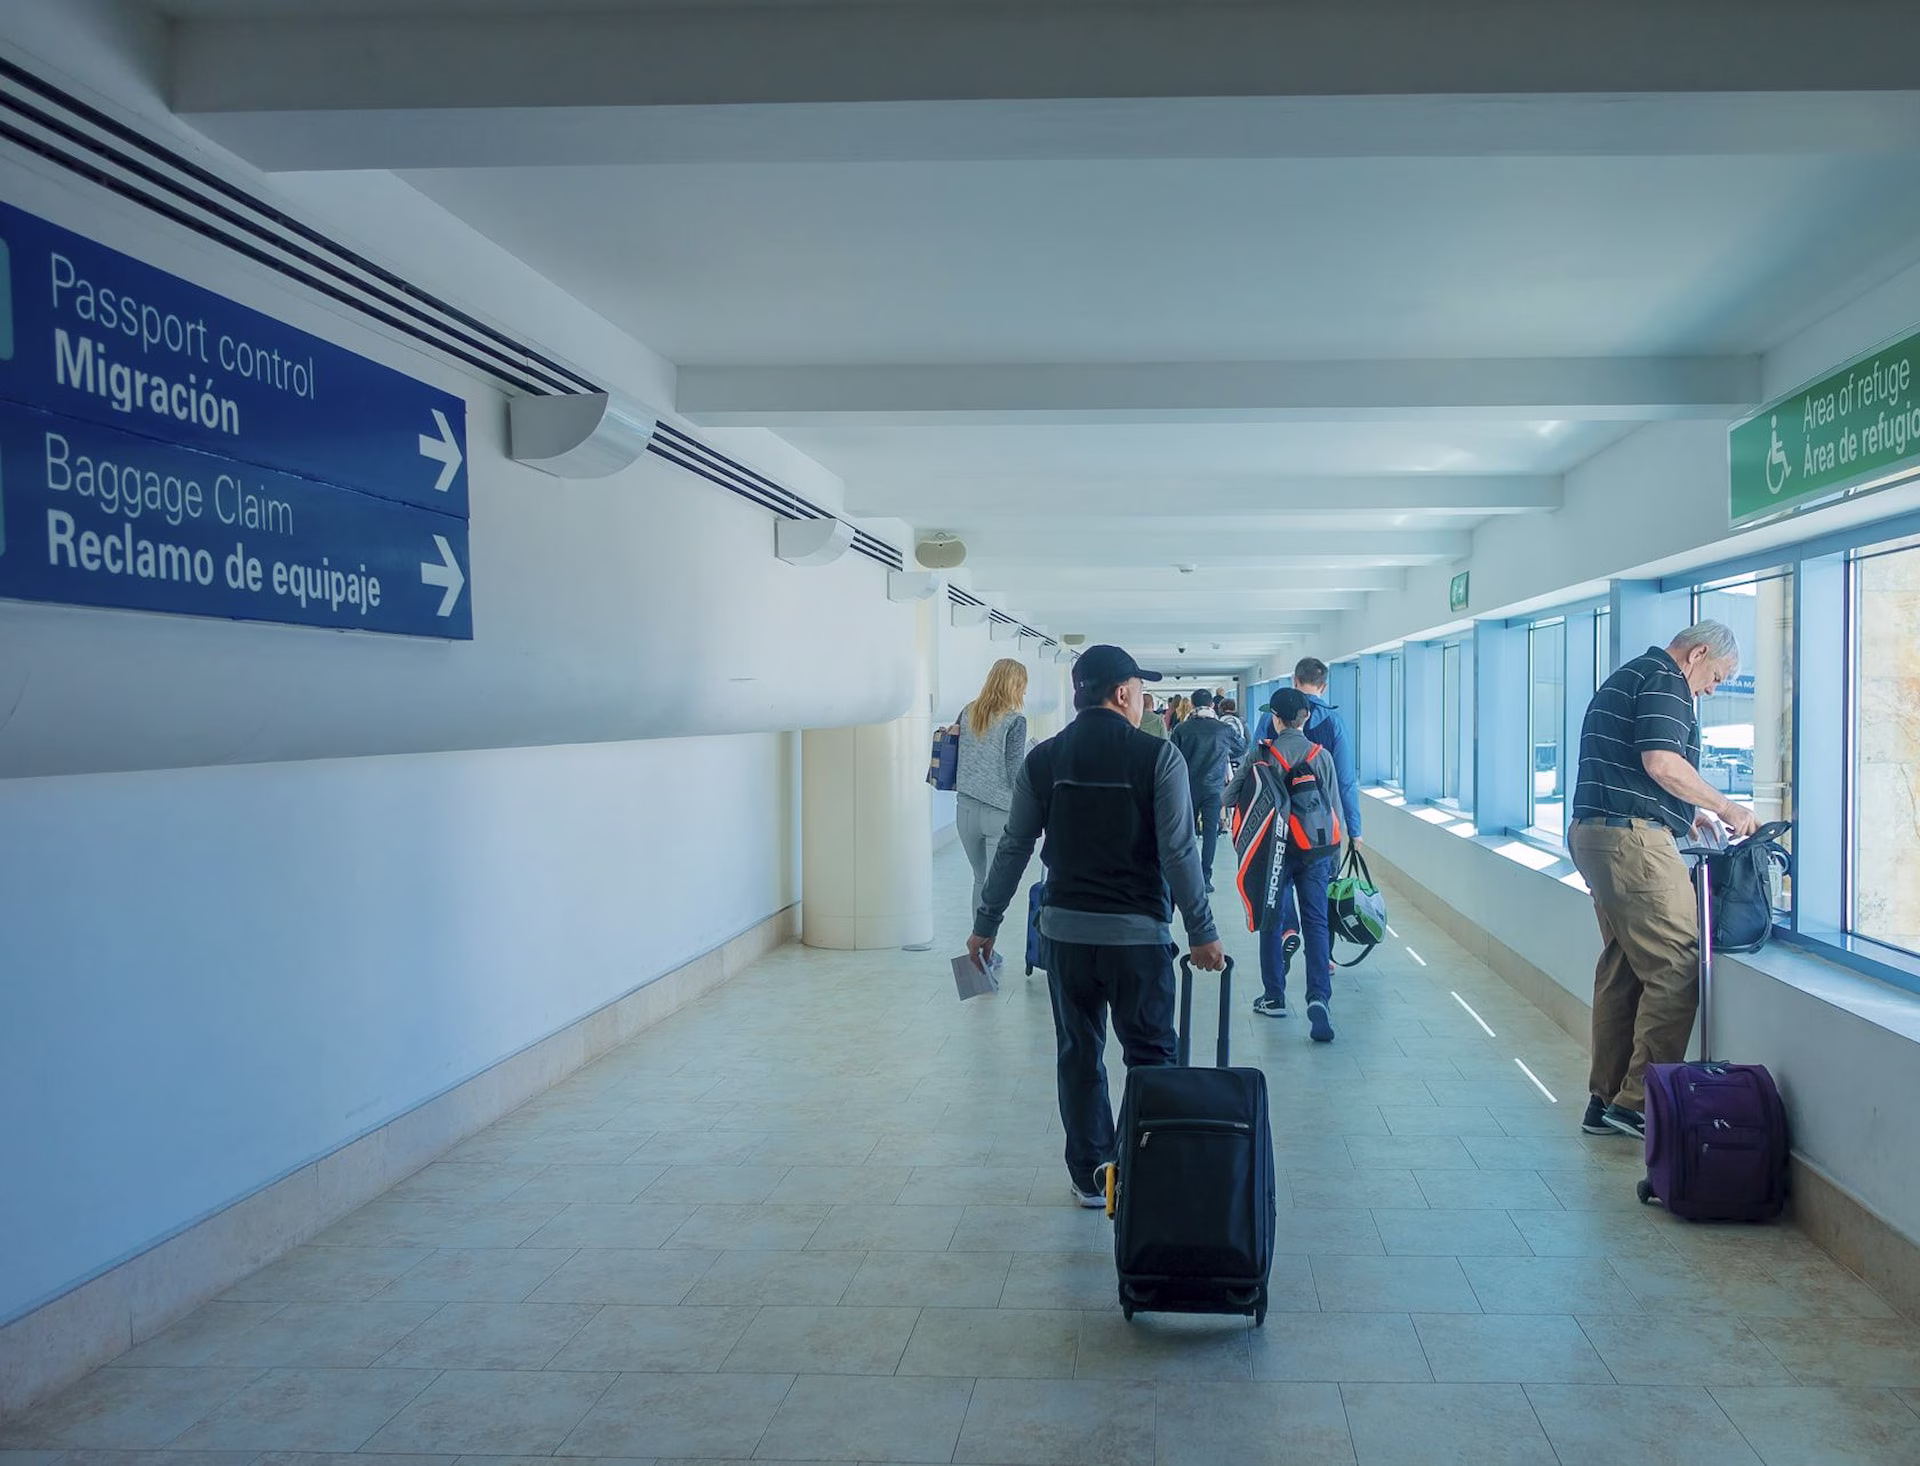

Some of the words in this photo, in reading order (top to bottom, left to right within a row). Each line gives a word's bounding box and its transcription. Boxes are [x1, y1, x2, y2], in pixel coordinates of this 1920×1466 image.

[51, 252, 208, 363] Passport
[219, 335, 314, 399] control
[54, 328, 239, 434] Migración
[1803, 393, 1834, 433] Area
[1839, 373, 1855, 415] of
[1858, 358, 1910, 408] refuge
[45, 432, 202, 526] Baggage
[215, 475, 293, 535] Claim
[1803, 434, 1834, 478] Área
[1839, 427, 1857, 464] de
[47, 508, 214, 586] Reclamo
[225, 542, 262, 592] de
[272, 557, 381, 615] equipaje
